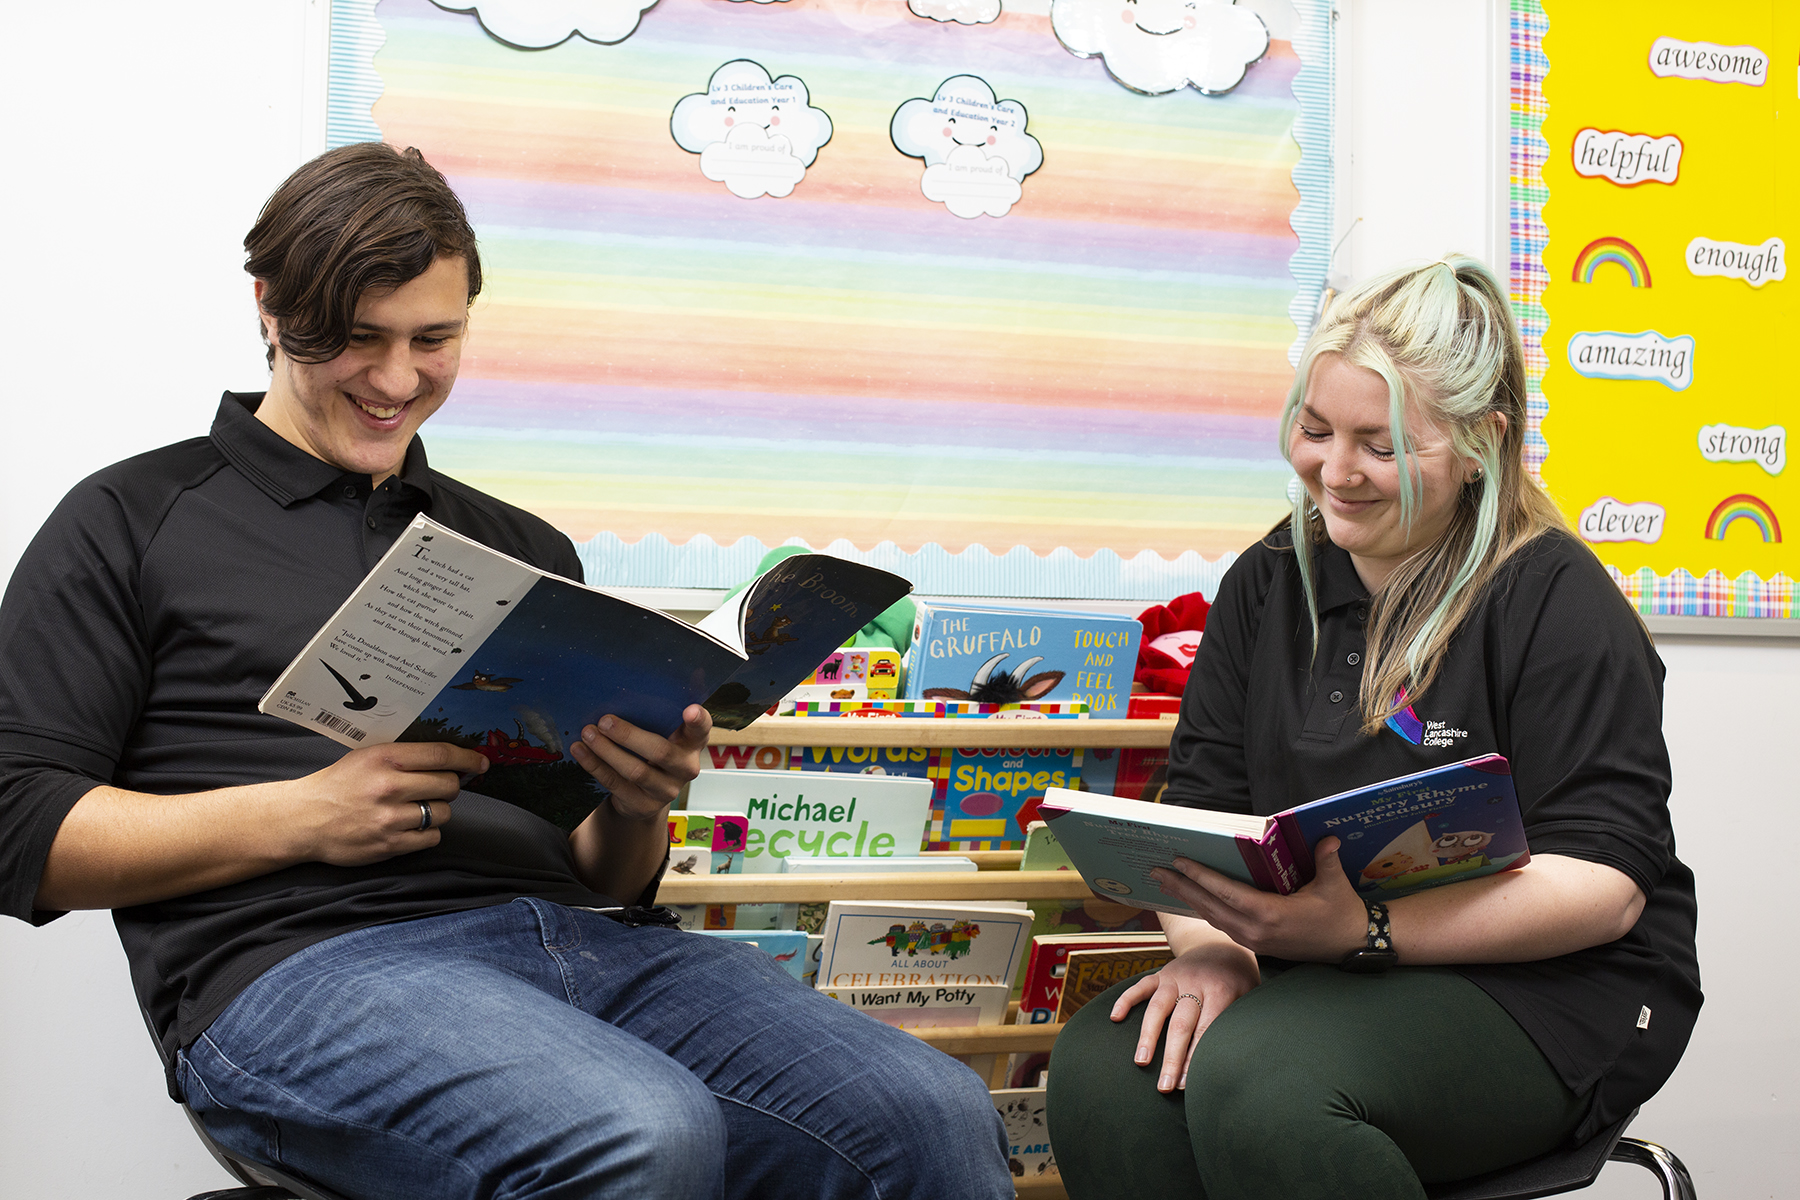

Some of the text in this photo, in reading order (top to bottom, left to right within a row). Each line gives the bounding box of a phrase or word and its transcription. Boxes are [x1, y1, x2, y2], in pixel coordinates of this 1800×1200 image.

[1657, 47, 1763, 76] awesome
[731, 83, 772, 91] Children's
[729, 97, 769, 105] Education
[956, 97, 995, 110] Children's
[997, 105, 1015, 114] Care
[933, 107, 948, 115] and
[951, 110, 989, 122] Education
[991, 117, 1009, 126] Year
[751, 143, 776, 153] proud
[778, 144, 786, 154] of
[1580, 136, 1676, 180] helpful
[970, 164, 993, 174] proud
[995, 165, 1004, 176] of
[1694, 244, 1779, 282] enough
[1579, 340, 1687, 380] amazing
[1705, 431, 1782, 466] strong
[1585, 502, 1660, 535] clever
[411, 544, 430, 562] The
[431, 560, 446, 569] witch
[447, 566, 460, 575] had
[394, 568, 455, 598] And long ginger hair
[436, 574, 448, 583] very
[460, 584, 471, 593] hat,
[380, 584, 396, 595] How
[396, 592, 406, 600] the
[416, 603, 438, 614] purred
[403, 584, 420, 594] which
[433, 597, 447, 606] wore
[459, 611, 474, 620] plait.
[798, 572, 859, 619] Broom
[375, 607, 388, 616] they
[408, 622, 422, 632] their
[422, 629, 456, 648] broomstick
[387, 601, 400, 609] and
[400, 605, 413, 614] how
[425, 618, 440, 628] witch
[439, 627, 464, 640] grinned,
[941, 618, 970, 636] THE
[330, 642, 340, 651] We
[340, 648, 357, 659] loved
[385, 623, 397, 632] flew
[398, 630, 421, 643] through
[422, 641, 431, 649] the
[433, 646, 448, 657] wind.
[930, 626, 1042, 659] GRUFFALO
[1074, 630, 1129, 649] TOUCH
[334, 636, 347, 646] have
[348, 643, 364, 654] come
[373, 656, 385, 664] with
[386, 662, 408, 675] another
[357, 637, 388, 656] Donaldson
[400, 659, 415, 668] Axel
[1084, 652, 1114, 668] AND
[385, 674, 425, 697] INDEPENDENT
[1076, 671, 1115, 690] FEEL
[1425, 728, 1468, 738] Lancashire
[1427, 721, 1446, 730] West
[1424, 738, 1454, 748] College
[1003, 759, 1024, 769] and
[954, 765, 1065, 797] Shapes
[1383, 780, 1423, 795] Sainsbury's
[1324, 782, 1489, 829] Nursery Rhyme
[1371, 786, 1430, 806] My First
[746, 794, 857, 823] Michael
[1359, 796, 1457, 825] Treasury
[1083, 821, 1137, 834] Nursery
[1143, 829, 1190, 843] Rhyme
[1107, 829, 1169, 844] Treasury
[1127, 821, 1151, 830] First
[746, 821, 895, 858] ecycle
[1271, 848, 1284, 875] Nursery
[891, 960, 949, 969] ALL ABOUT
[1075, 958, 1176, 993] FARME
[851, 989, 976, 1007] I Want My Potty
[1023, 1144, 1050, 1155] ARE
